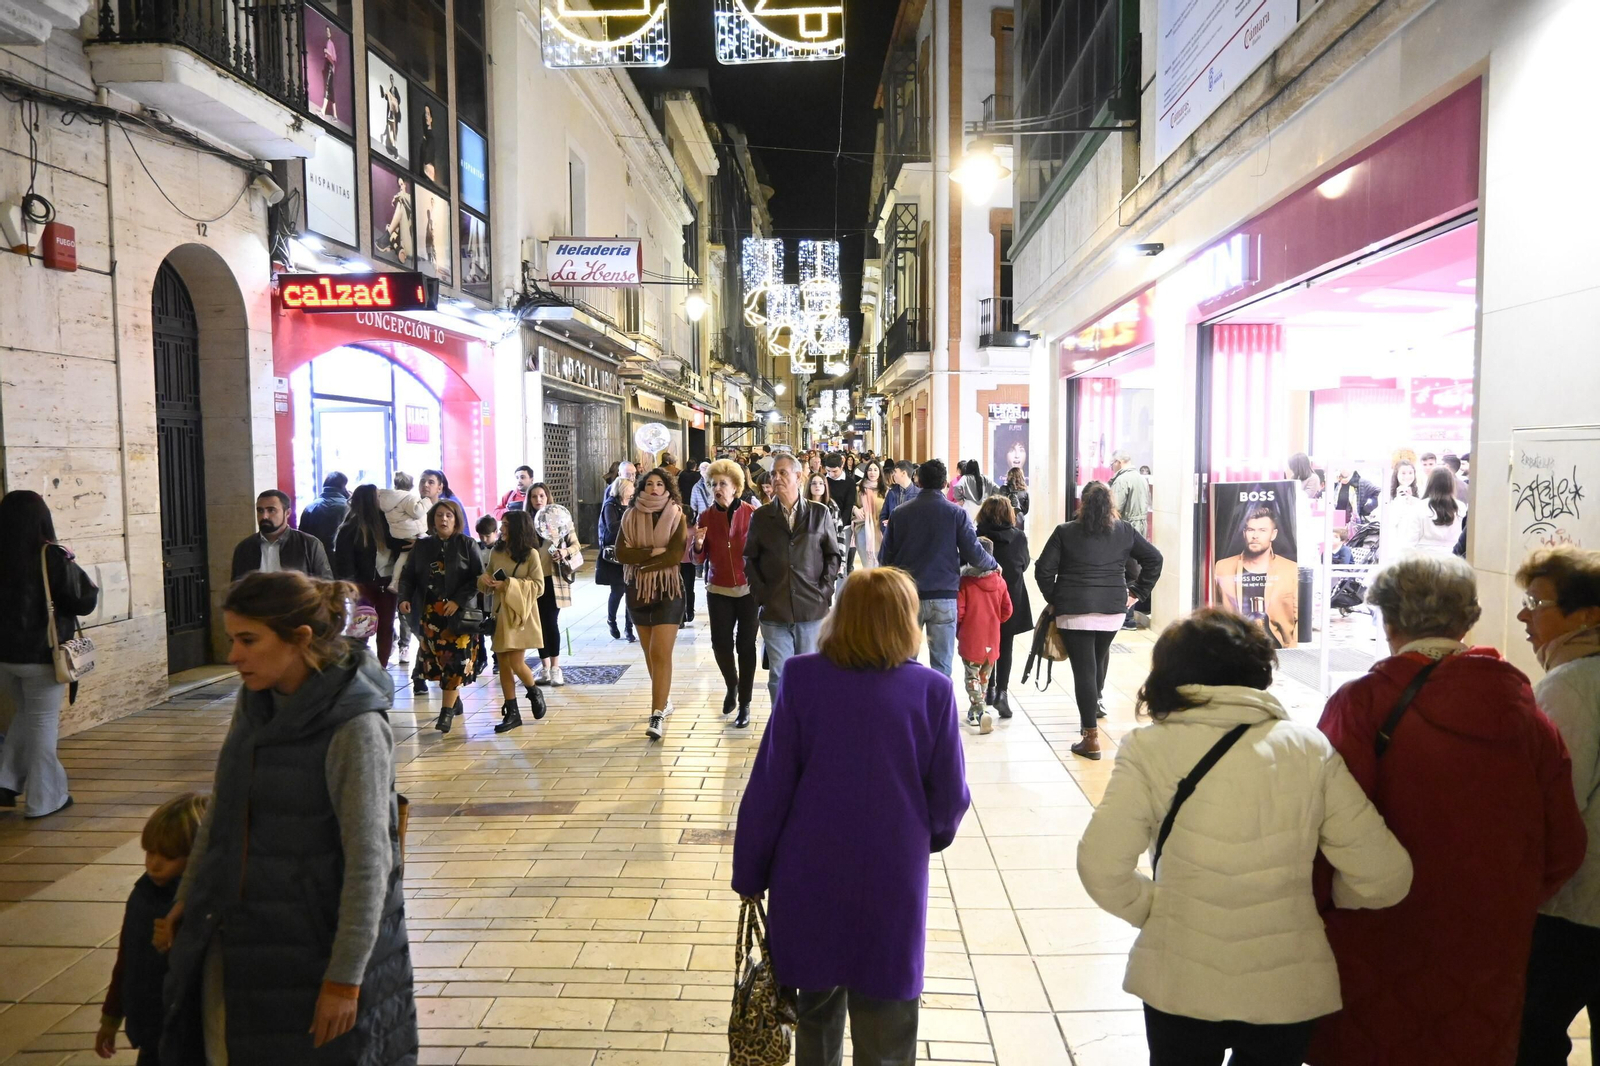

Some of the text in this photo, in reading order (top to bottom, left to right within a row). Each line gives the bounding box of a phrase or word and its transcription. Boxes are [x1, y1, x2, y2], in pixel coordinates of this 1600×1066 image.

[1244, 11, 1270, 49] Cámara
[460, 158, 485, 181] HISPANITAS
[309, 173, 350, 200] HISPANITAS
[196, 222, 208, 237] 12
[56, 236, 76, 248] FUEGO
[551, 259, 578, 281] La
[283, 277, 391, 306] calzad
[356, 311, 445, 344] CONCEPCIÓN 10
[1239, 491, 1275, 502] BOSS
